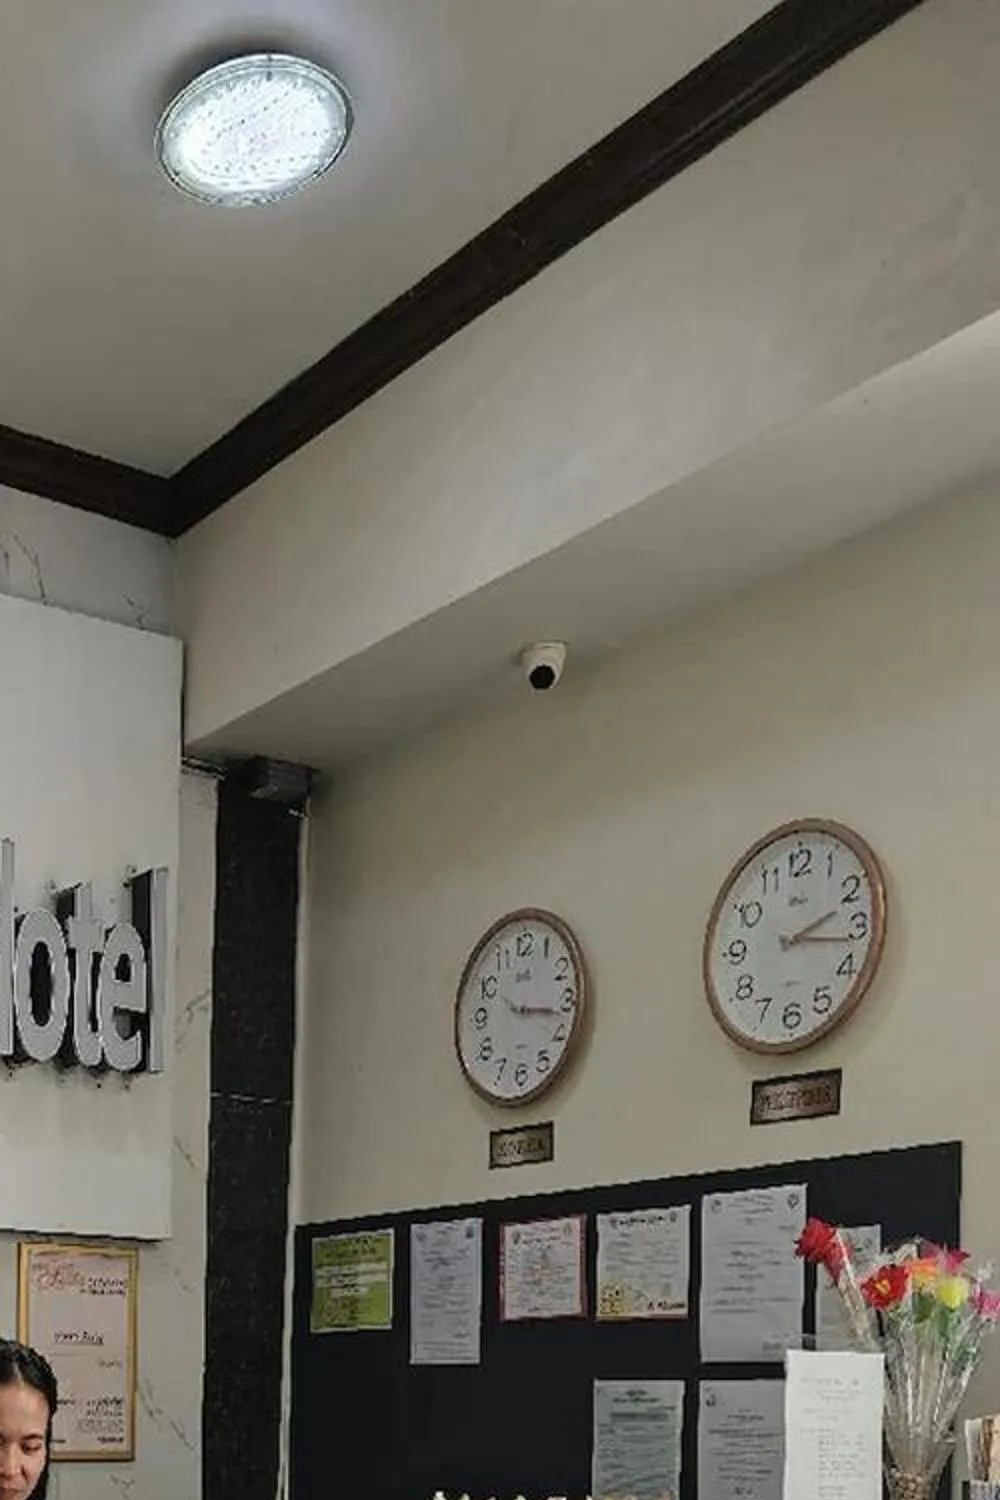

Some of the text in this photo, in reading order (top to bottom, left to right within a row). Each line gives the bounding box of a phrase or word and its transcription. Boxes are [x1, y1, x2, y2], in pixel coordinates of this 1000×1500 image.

[789, 849, 811, 878] 12
[826, 852, 833, 879] 1
[761, 867, 779, 894] 11
[841, 875, 861, 903] 2
[738, 901, 763, 928] 10
[848, 911, 868, 940] 3
[516, 931, 534, 957] 12
[543, 936, 549, 959] 1
[728, 939, 747, 965] 9
[496, 949, 510, 971] 11
[555, 957, 568, 981] 2
[836, 953, 857, 978] 4
[481, 976, 498, 999] 10
[560, 987, 574, 1012] 3
[736, 975, 753, 1001] 8
[812, 986, 832, 1014] 5
[475, 1007, 488, 1030] 9
[756, 998, 772, 1024] 7
[782, 1002, 802, 1029] 6
[515, 1062, 529, 1086] 6
[535, 1050, 550, 1073] 5
